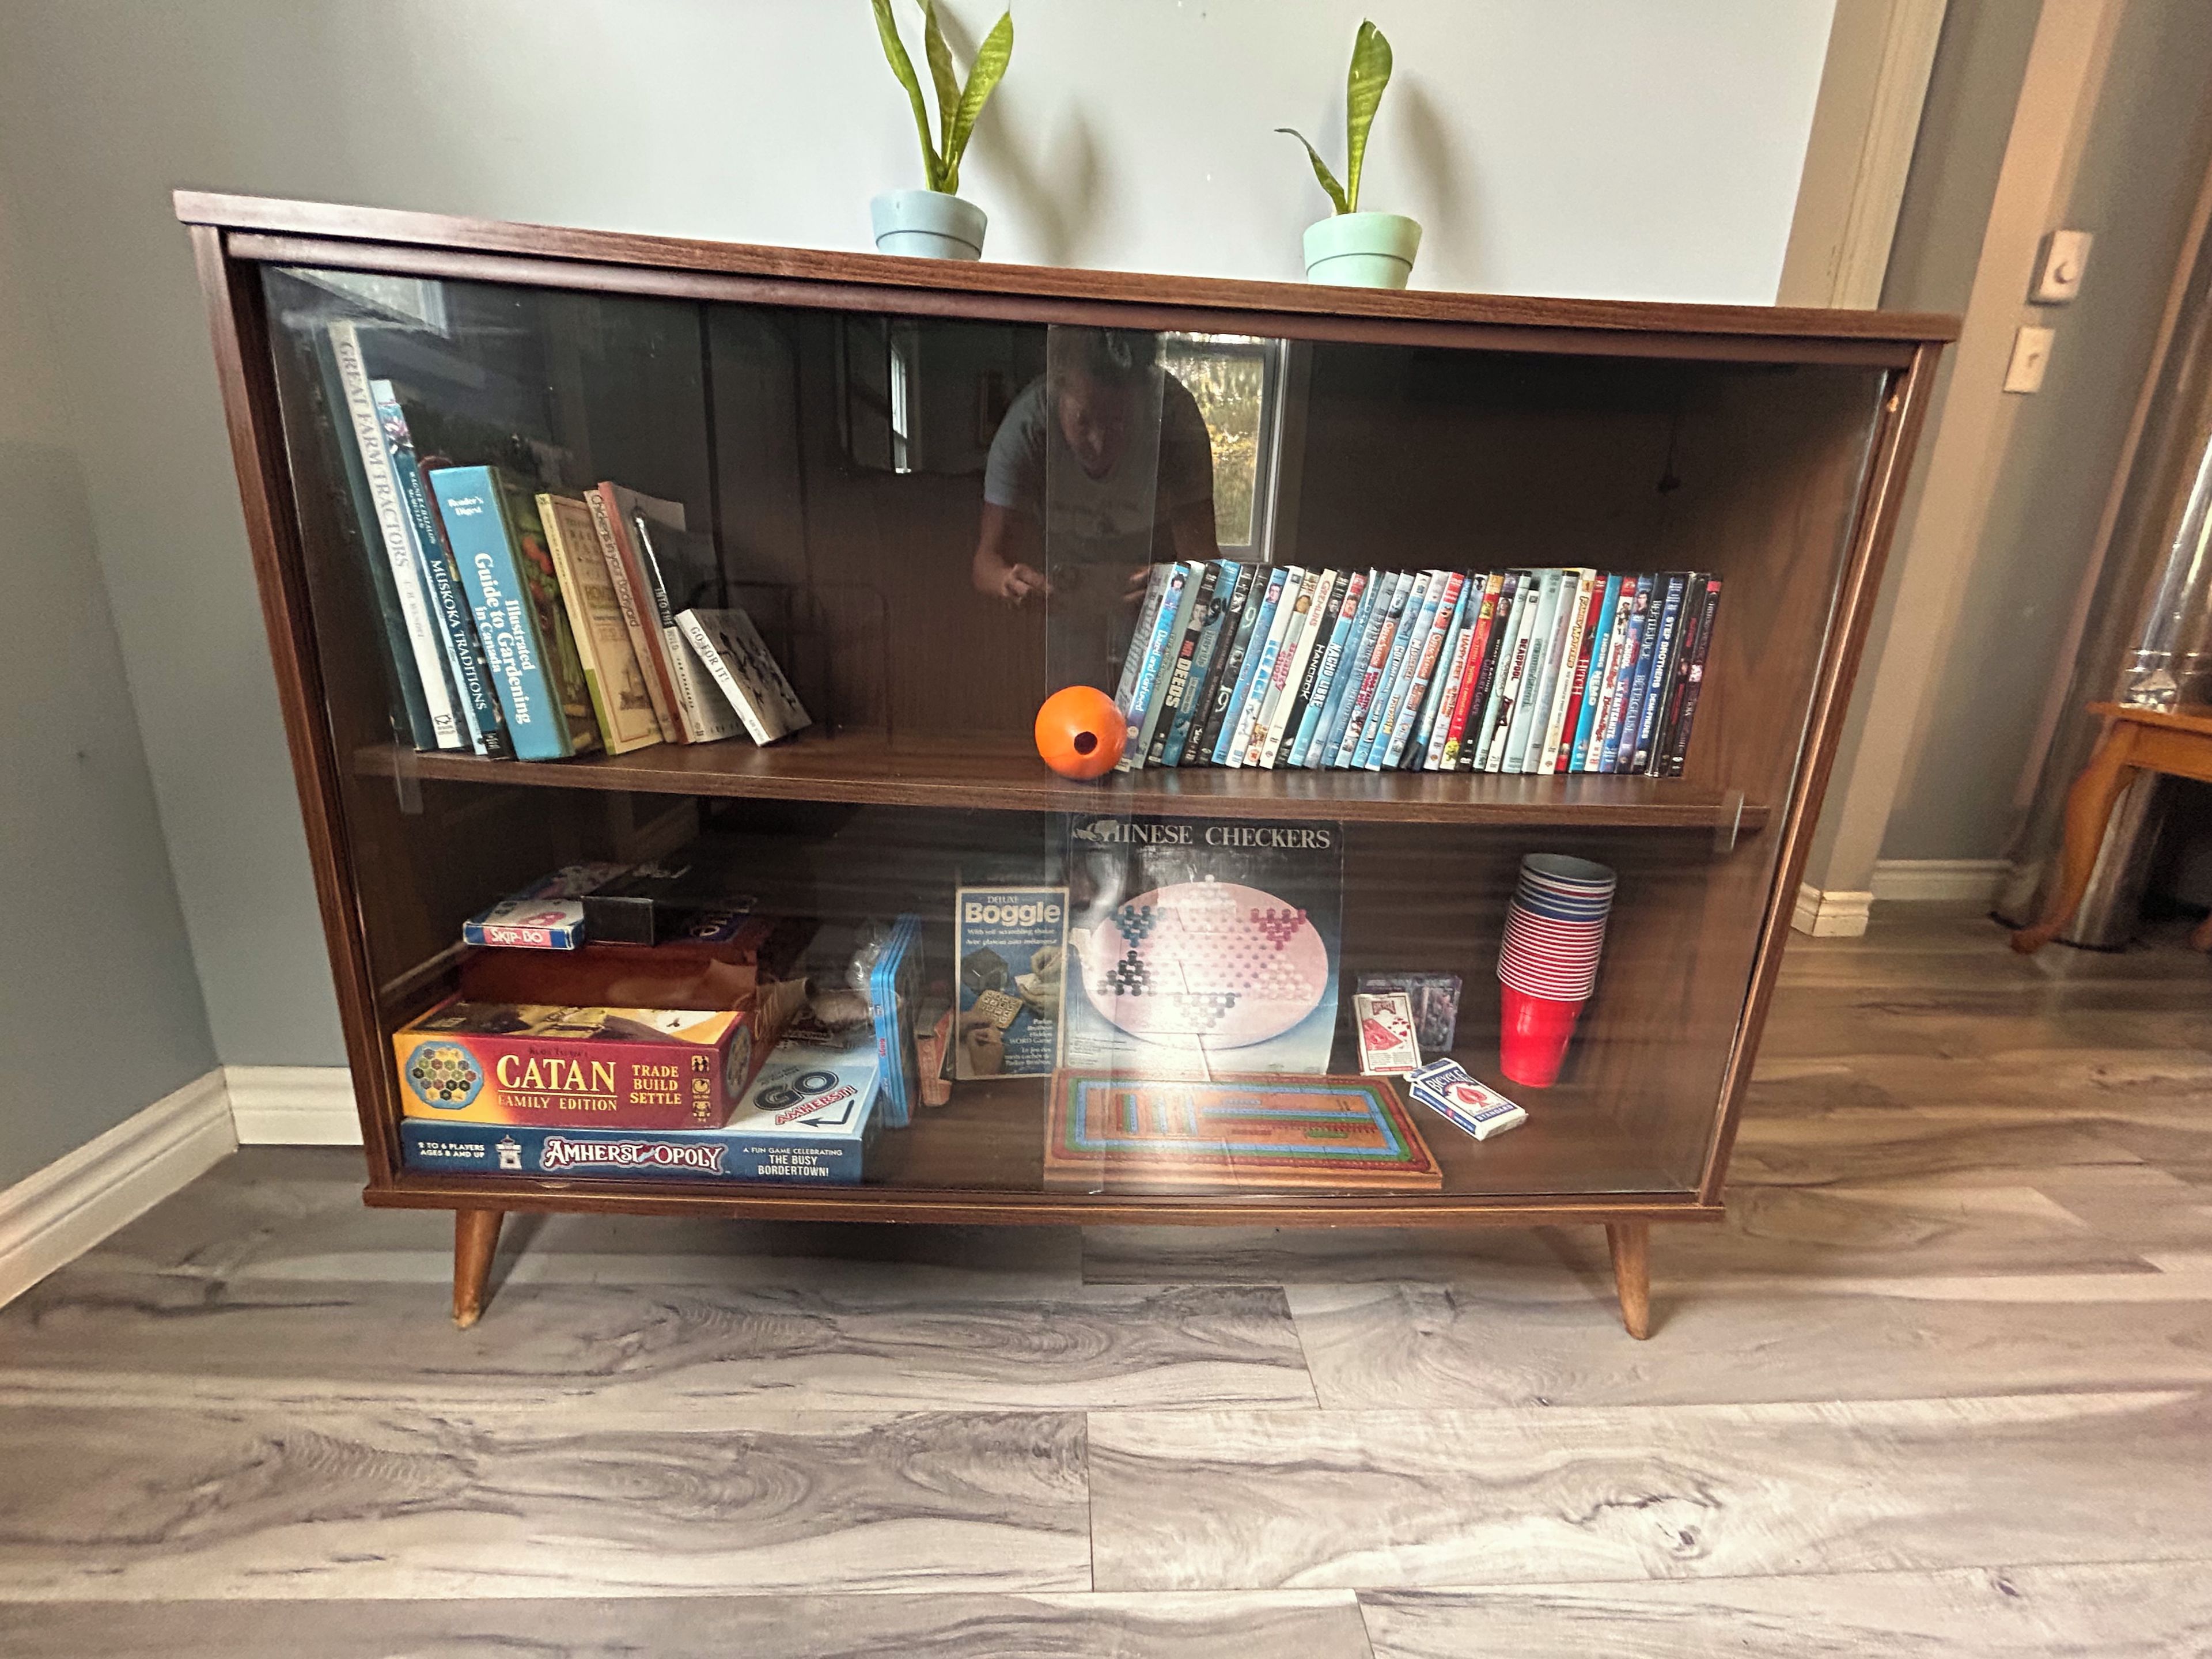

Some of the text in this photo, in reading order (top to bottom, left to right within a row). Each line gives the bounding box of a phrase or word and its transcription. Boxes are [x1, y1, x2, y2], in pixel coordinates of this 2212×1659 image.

[340, 342, 409, 567] GREAT FARM TRACTORS
[592, 494, 612, 540] Chickens
[619, 579, 641, 627] Backyard
[654, 588, 668, 609] INTO
[661, 610, 674, 627] THE
[1243, 606, 1257, 629] 9
[1308, 580, 1330, 627] GREMLINS
[430, 559, 488, 711] MUSKOKA TRADITIONS
[474, 552, 532, 725] Guide to Gardening
[474, 606, 503, 673] in Canada
[505, 599, 536, 671] Illustrated
[1152, 629, 1168, 656] Dazed
[1567, 596, 1590, 669] FAMILY MATTERS
[1641, 600, 1662, 660] BEETLEJUICE
[1664, 616, 1675, 639] STEP
[691, 626, 730, 683] GO FOR IT!
[1147, 656, 1160, 671] and
[1452, 633, 1470, 680] HAPPY FEET
[1484, 638, 1502, 692] WHAT'S EATING
[1510, 637, 1529, 682] DEADPOOL
[1597, 633, 1610, 669] FINDING
[1621, 638, 1634, 669] SCHOOL
[1652, 640, 1671, 688] BROTHERS
[1165, 658, 1192, 709] DEEDS
[1251, 639, 1280, 701] ICE AGE
[1300, 643, 1325, 700] HANCOCK
[1308, 642, 1342, 709] NACHO LIBRE
[1571, 659, 1590, 696] HITCH
[1616, 681, 1624, 693] LA
[1135, 672, 1156, 712] Confused
[1215, 692, 1230, 714] 9
[1589, 671, 1603, 707] NEMO
[1205, 827, 1331, 849] CHECKERS
[965, 901, 1061, 927] Boggle
[490, 928, 544, 945] SKIP-BO
[496, 1054, 617, 1093] CATAN
[632, 1064, 680, 1078] TRADE
[634, 1078, 679, 1092] BUILD
[1426, 1069, 1469, 1092] BICYCLE
[498, 1094, 617, 1111] FAMILY EDITION
[630, 1092, 682, 1105] SETTLE
[753, 1070, 839, 1111] GO
[1475, 1104, 1514, 1121] STANDARD
[449, 1143, 485, 1151] PLAYERS
[768, 1154, 819, 1165] THE BUSY
[793, 1148, 843, 1156] CELEBRATING
[757, 1165, 829, 1177] BORDERTOWN!
